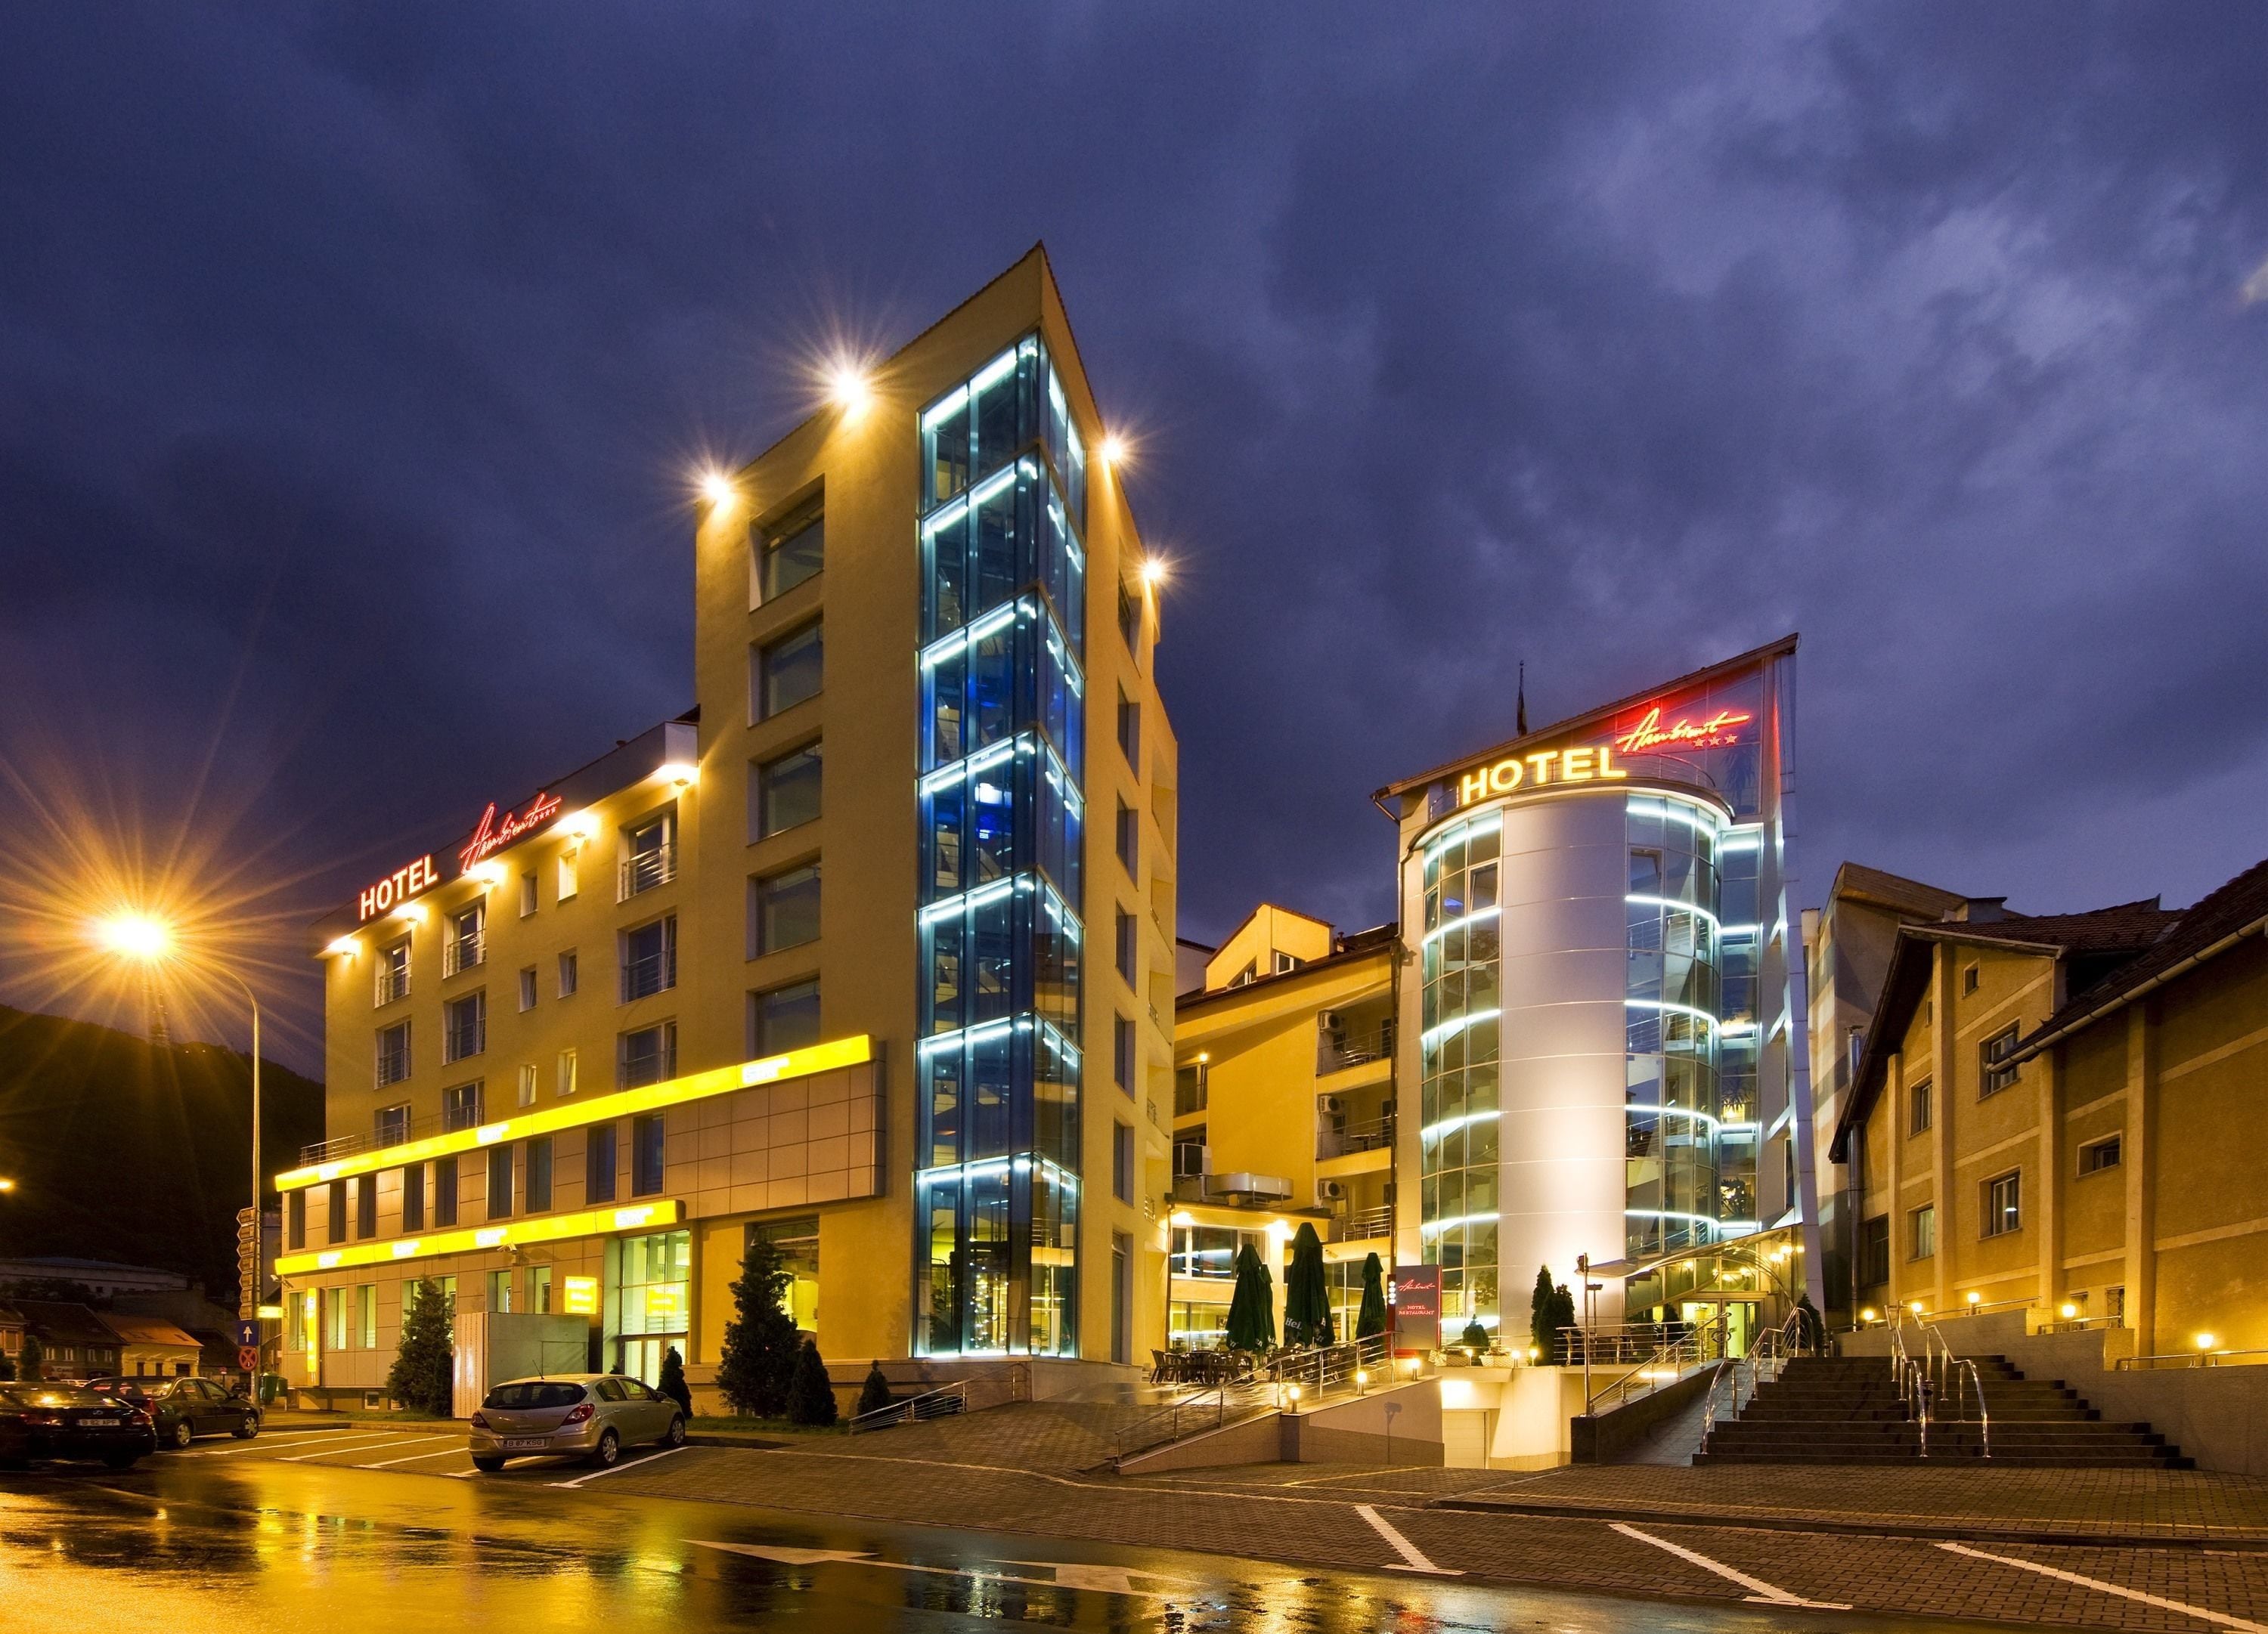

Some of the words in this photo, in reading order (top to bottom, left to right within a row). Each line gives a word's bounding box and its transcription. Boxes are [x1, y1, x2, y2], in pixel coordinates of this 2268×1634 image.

[1615, 707, 1750, 753] Ambient
[1463, 746, 1627, 804] HOTEL
[460, 793, 562, 874] Ambient
[360, 854, 438, 921] HOTEL
